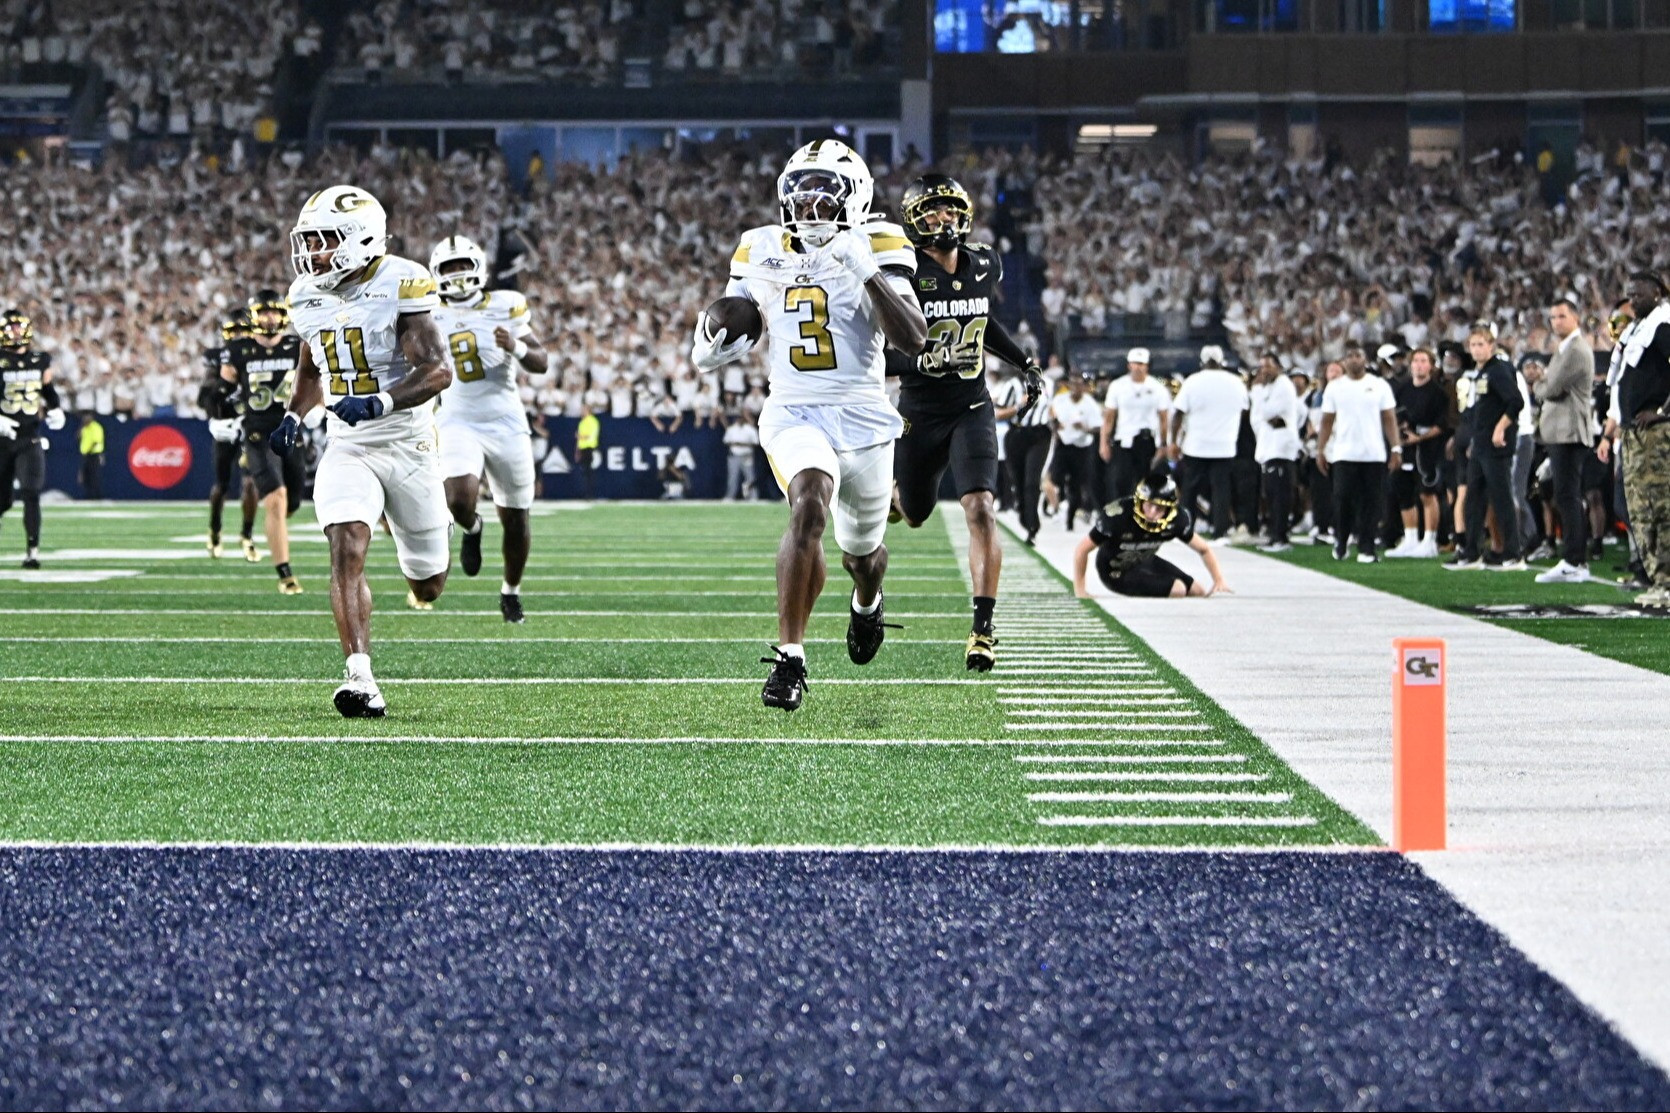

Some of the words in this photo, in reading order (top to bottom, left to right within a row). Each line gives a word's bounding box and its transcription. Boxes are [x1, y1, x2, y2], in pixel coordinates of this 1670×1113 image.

[760, 257, 785, 268] ACC
[784, 284, 837, 371] 3
[924, 297, 989, 318] COLORADO
[319, 327, 380, 396] 11
[448, 329, 486, 383] 8
[248, 369, 296, 411] 54
[1405, 656, 1439, 678] GT
